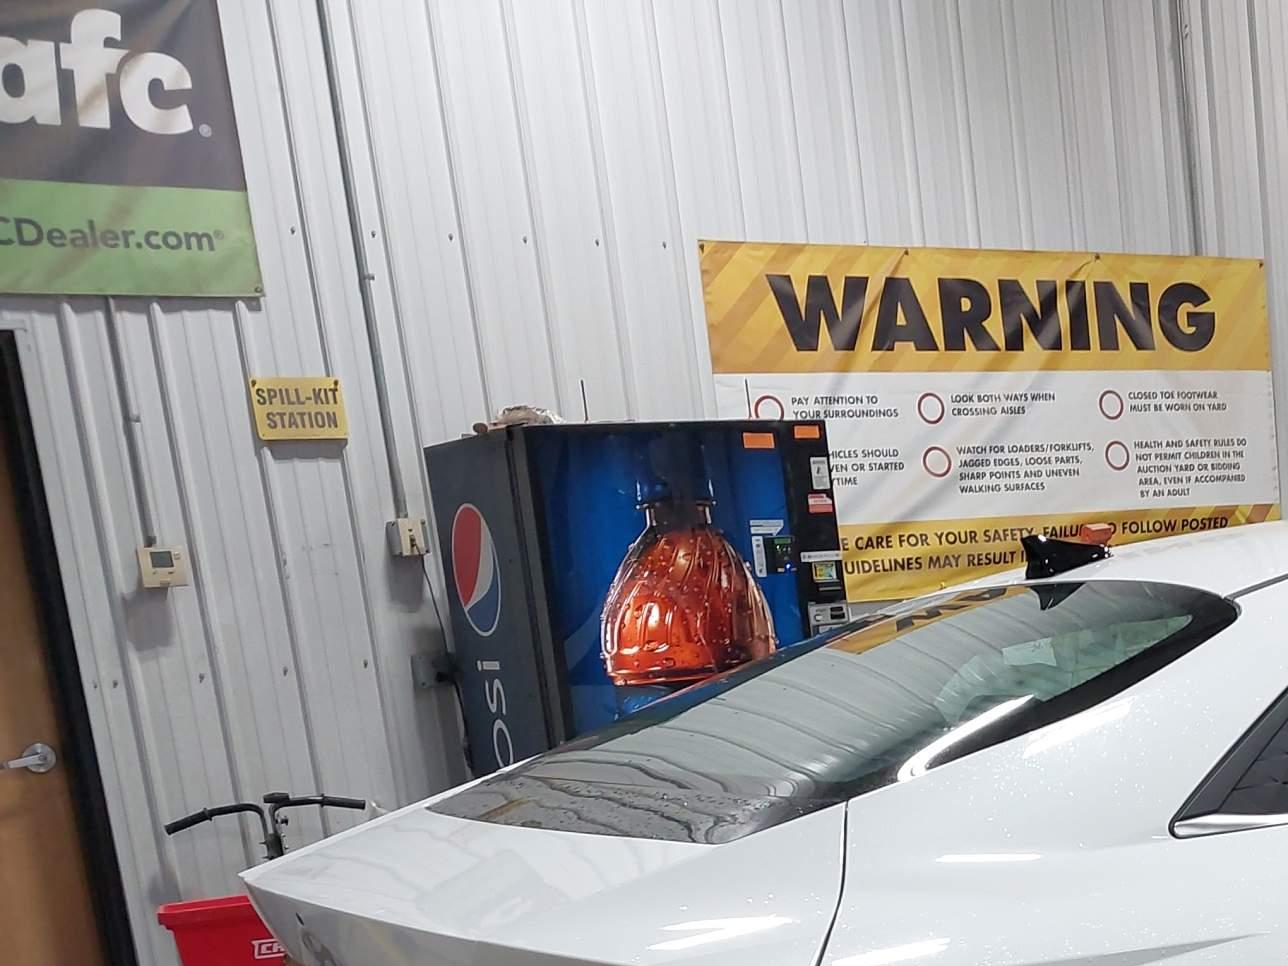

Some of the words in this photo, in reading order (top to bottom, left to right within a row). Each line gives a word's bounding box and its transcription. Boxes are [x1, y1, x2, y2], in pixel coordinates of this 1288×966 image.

[766, 274, 1216, 353] WARNING
[255, 387, 339, 405] SPILL-KIT
[791, 397, 809, 405] PAY
[814, 395, 863, 405] ATTENTION
[865, 395, 878, 404] TO
[951, 395, 974, 403] LOOK
[977, 394, 1000, 403] BOTH
[1004, 393, 1028, 402] WAYS
[1031, 393, 1055, 401] WHEN
[1128, 392, 1157, 400] CLOSED
[1177, 391, 1218, 399] FOOTWEAR
[952, 407, 997, 416] CROSSING
[1000, 406, 1025, 415] AISLES
[1130, 404, 1150, 412] MUST
[1154, 403, 1162, 411] BE
[1166, 403, 1191, 411] WORN
[1193, 403, 1205, 411] ON
[1207, 403, 1227, 411] YARD
[793, 410, 821, 419] YOUR
[823, 409, 899, 419] SURROUNDINGS
[266, 411, 339, 429] STATION
[1134, 441, 1162, 449] HEALTH
[1166, 440, 1183, 448] AND
[1186, 439, 1211, 447] SAFETY
[1214, 439, 1234, 447] RULES
[1237, 438, 1246, 446] DO
[861, 449, 899, 458] SHOULD
[957, 446, 986, 454] WATCH
[989, 445, 1005, 454] FOR
[1136, 453, 1151, 461] NOT
[1155, 452, 1181, 460] PERMIT
[1184, 451, 1220, 459] CHILDREN
[1233, 450, 1244, 458] THE
[851, 463, 865, 471] OR
[869, 462, 904, 471] STARTED
[959, 459, 990, 468] JAGGED
[994, 458, 1022, 467] EDGES,
[1025, 457, 1052, 465] LOOSE
[1137, 465, 1171, 473] AUCTION
[1174, 464, 1194, 472] YARD
[1198, 463, 1208, 471] OR
[1211, 462, 1240, 470] BIDDING
[959, 472, 986, 480] SHARP
[990, 471, 1021, 479] POINTS
[1024, 470, 1042, 478] AND
[1045, 468, 1079, 477] UNEVEN
[1164, 476, 1183, 485] EVEN
[1186, 476, 1191, 484] IF
[1194, 475, 1245, 483] ACCOMPANIED
[960, 484, 1001, 493] WALKING
[1004, 482, 1045, 491] SURFACES
[1140, 490, 1149, 498] BY
[1153, 489, 1164, 497] AN
[1167, 488, 1190, 496] ADULT
[855, 536, 893, 550] CARE
[899, 533, 929, 547] FOR
[934, 530, 978, 545] YOUR
[1122, 519, 1177, 534] FOLLOW
[1181, 516, 1228, 531] POSTED
[928, 553, 961, 569] MAY
[967, 551, 1016, 567] RESULT
